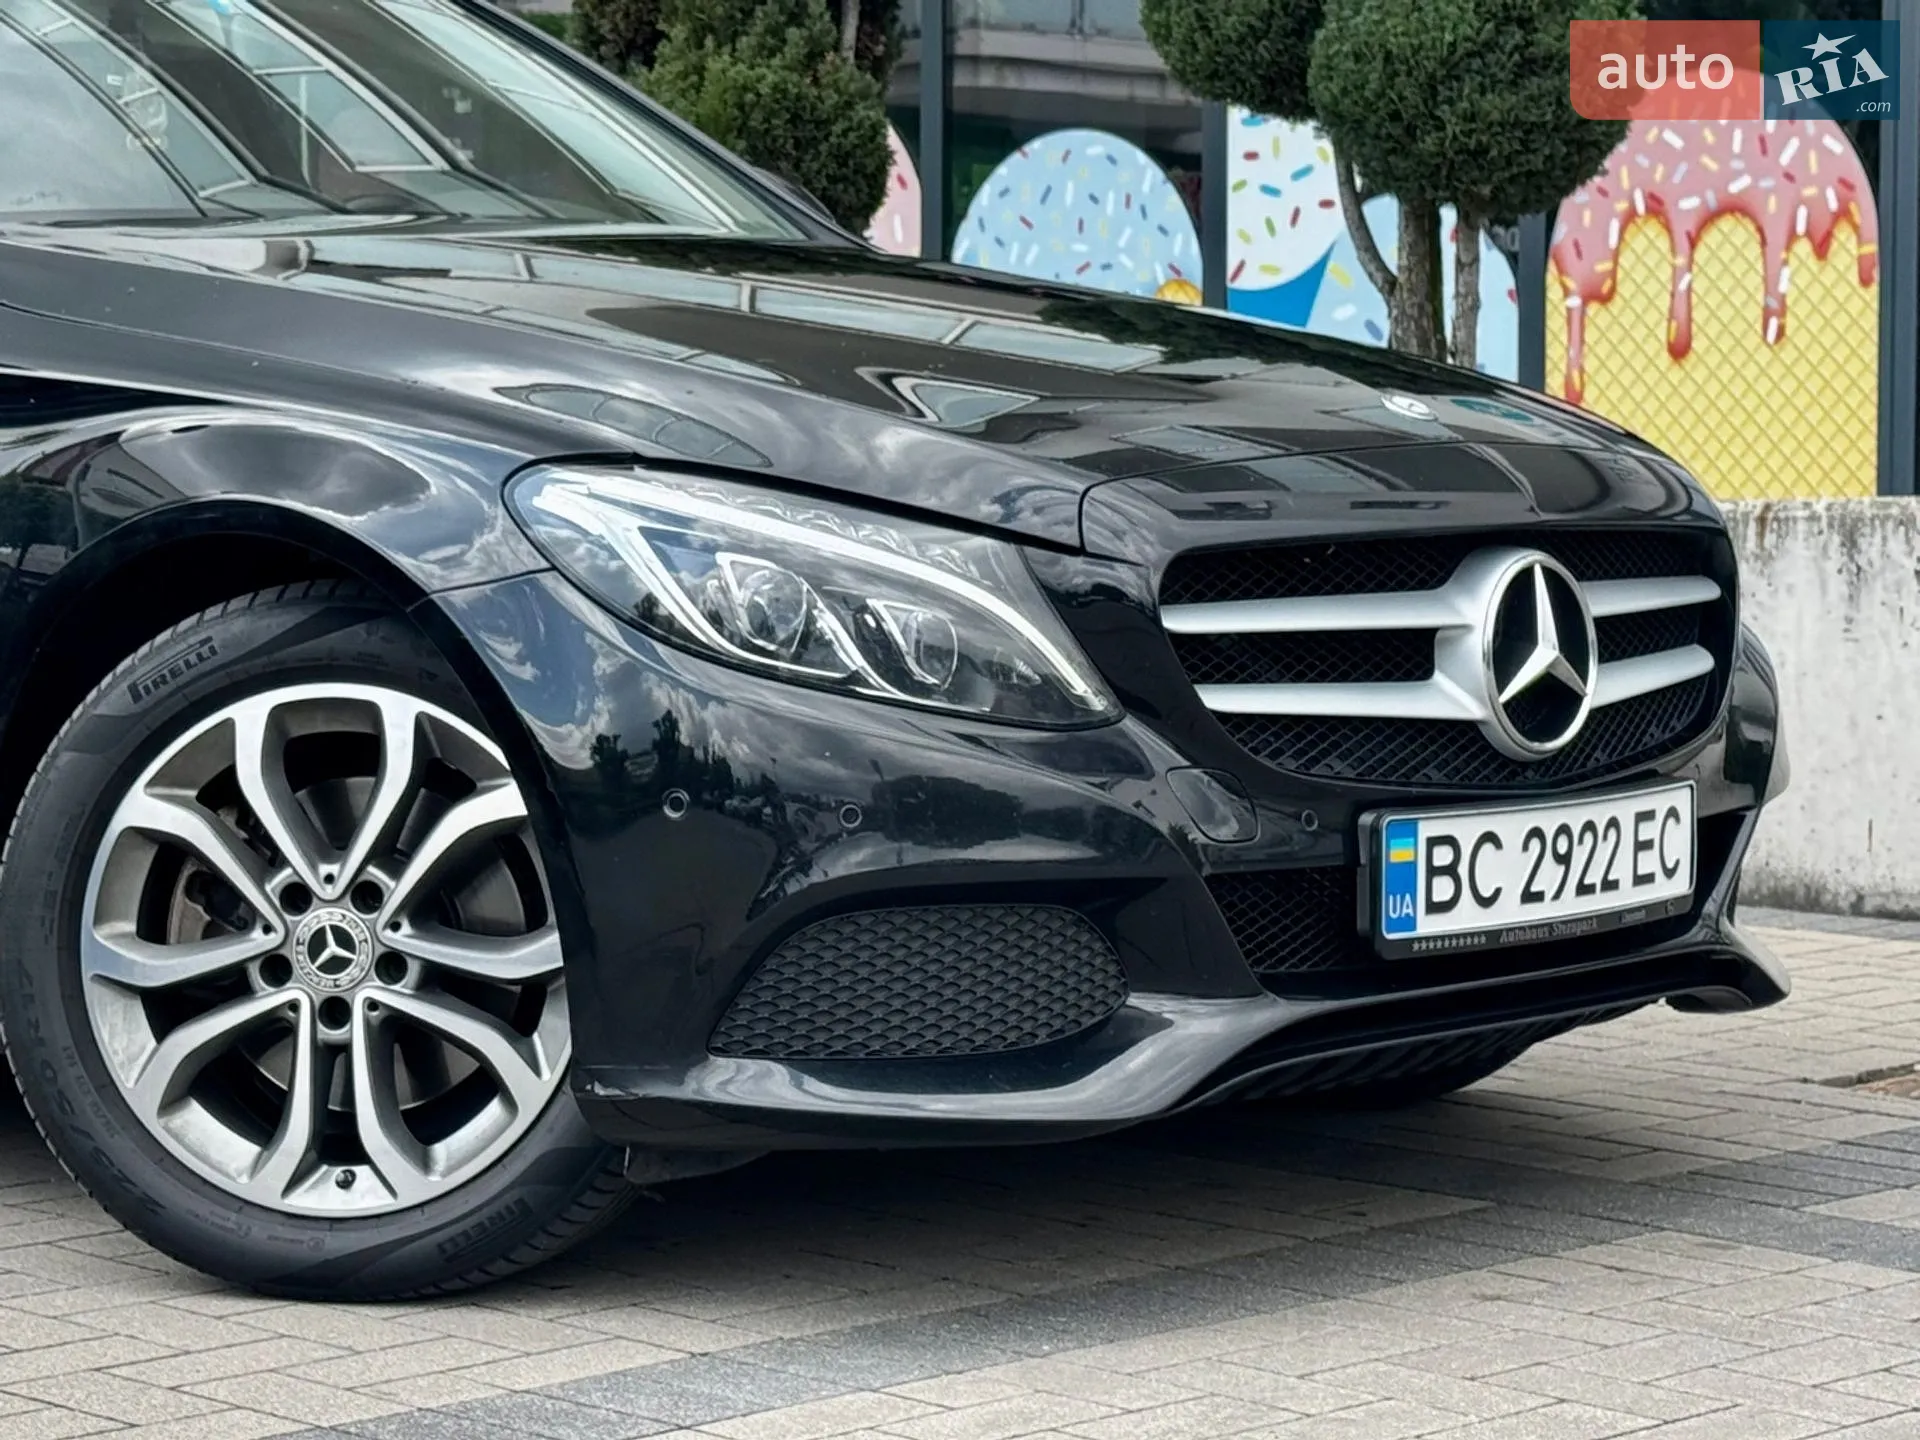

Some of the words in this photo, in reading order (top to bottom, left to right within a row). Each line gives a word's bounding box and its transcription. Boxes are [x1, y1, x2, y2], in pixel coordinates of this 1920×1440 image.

[126, 635, 219, 704] PIRELLI
[1424, 830, 1504, 916] BC
[1519, 815, 1622, 905] 2922
[1631, 805, 1681, 888] EC
[1388, 893, 1415, 918] UA
[1500, 926, 1548, 943] Autohaus
[437, 1197, 533, 1263] PIRELLI
